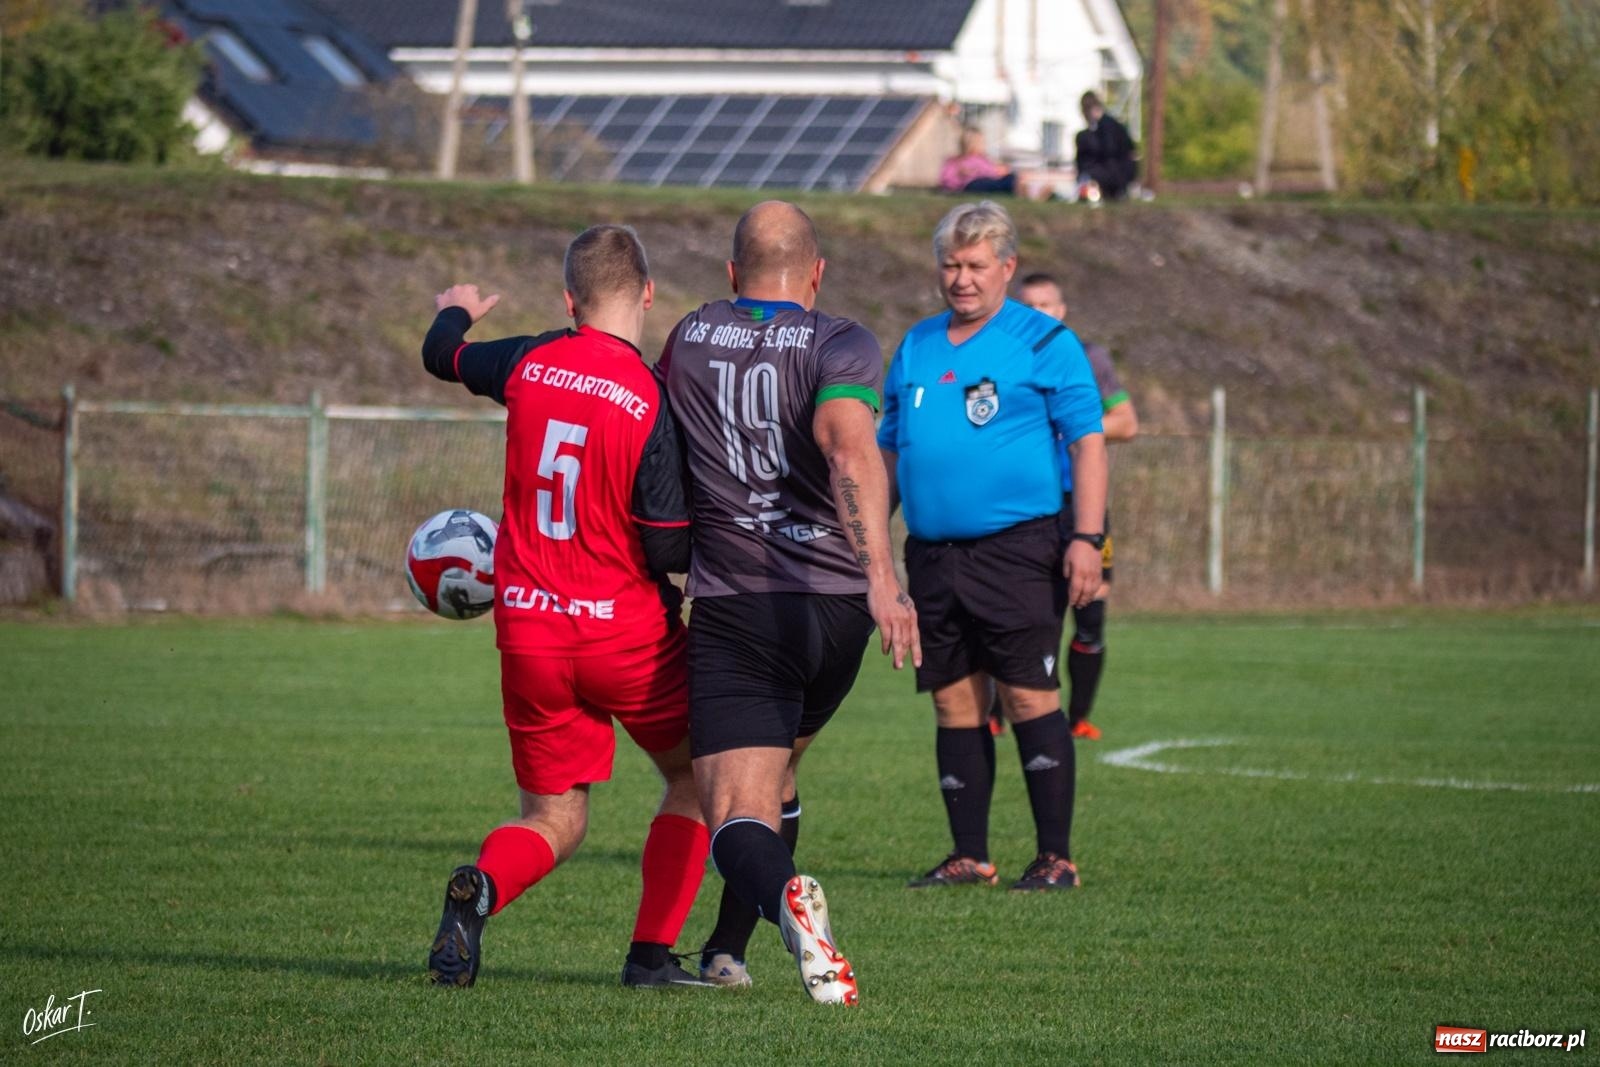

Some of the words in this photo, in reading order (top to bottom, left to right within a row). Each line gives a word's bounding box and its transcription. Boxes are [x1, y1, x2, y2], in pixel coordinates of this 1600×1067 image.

[521, 361, 545, 382] KS
[542, 366, 650, 421] GOTARTOWICE
[708, 360, 791, 484] 19
[536, 418, 589, 541] 5
[503, 585, 616, 620] CUTLINE
